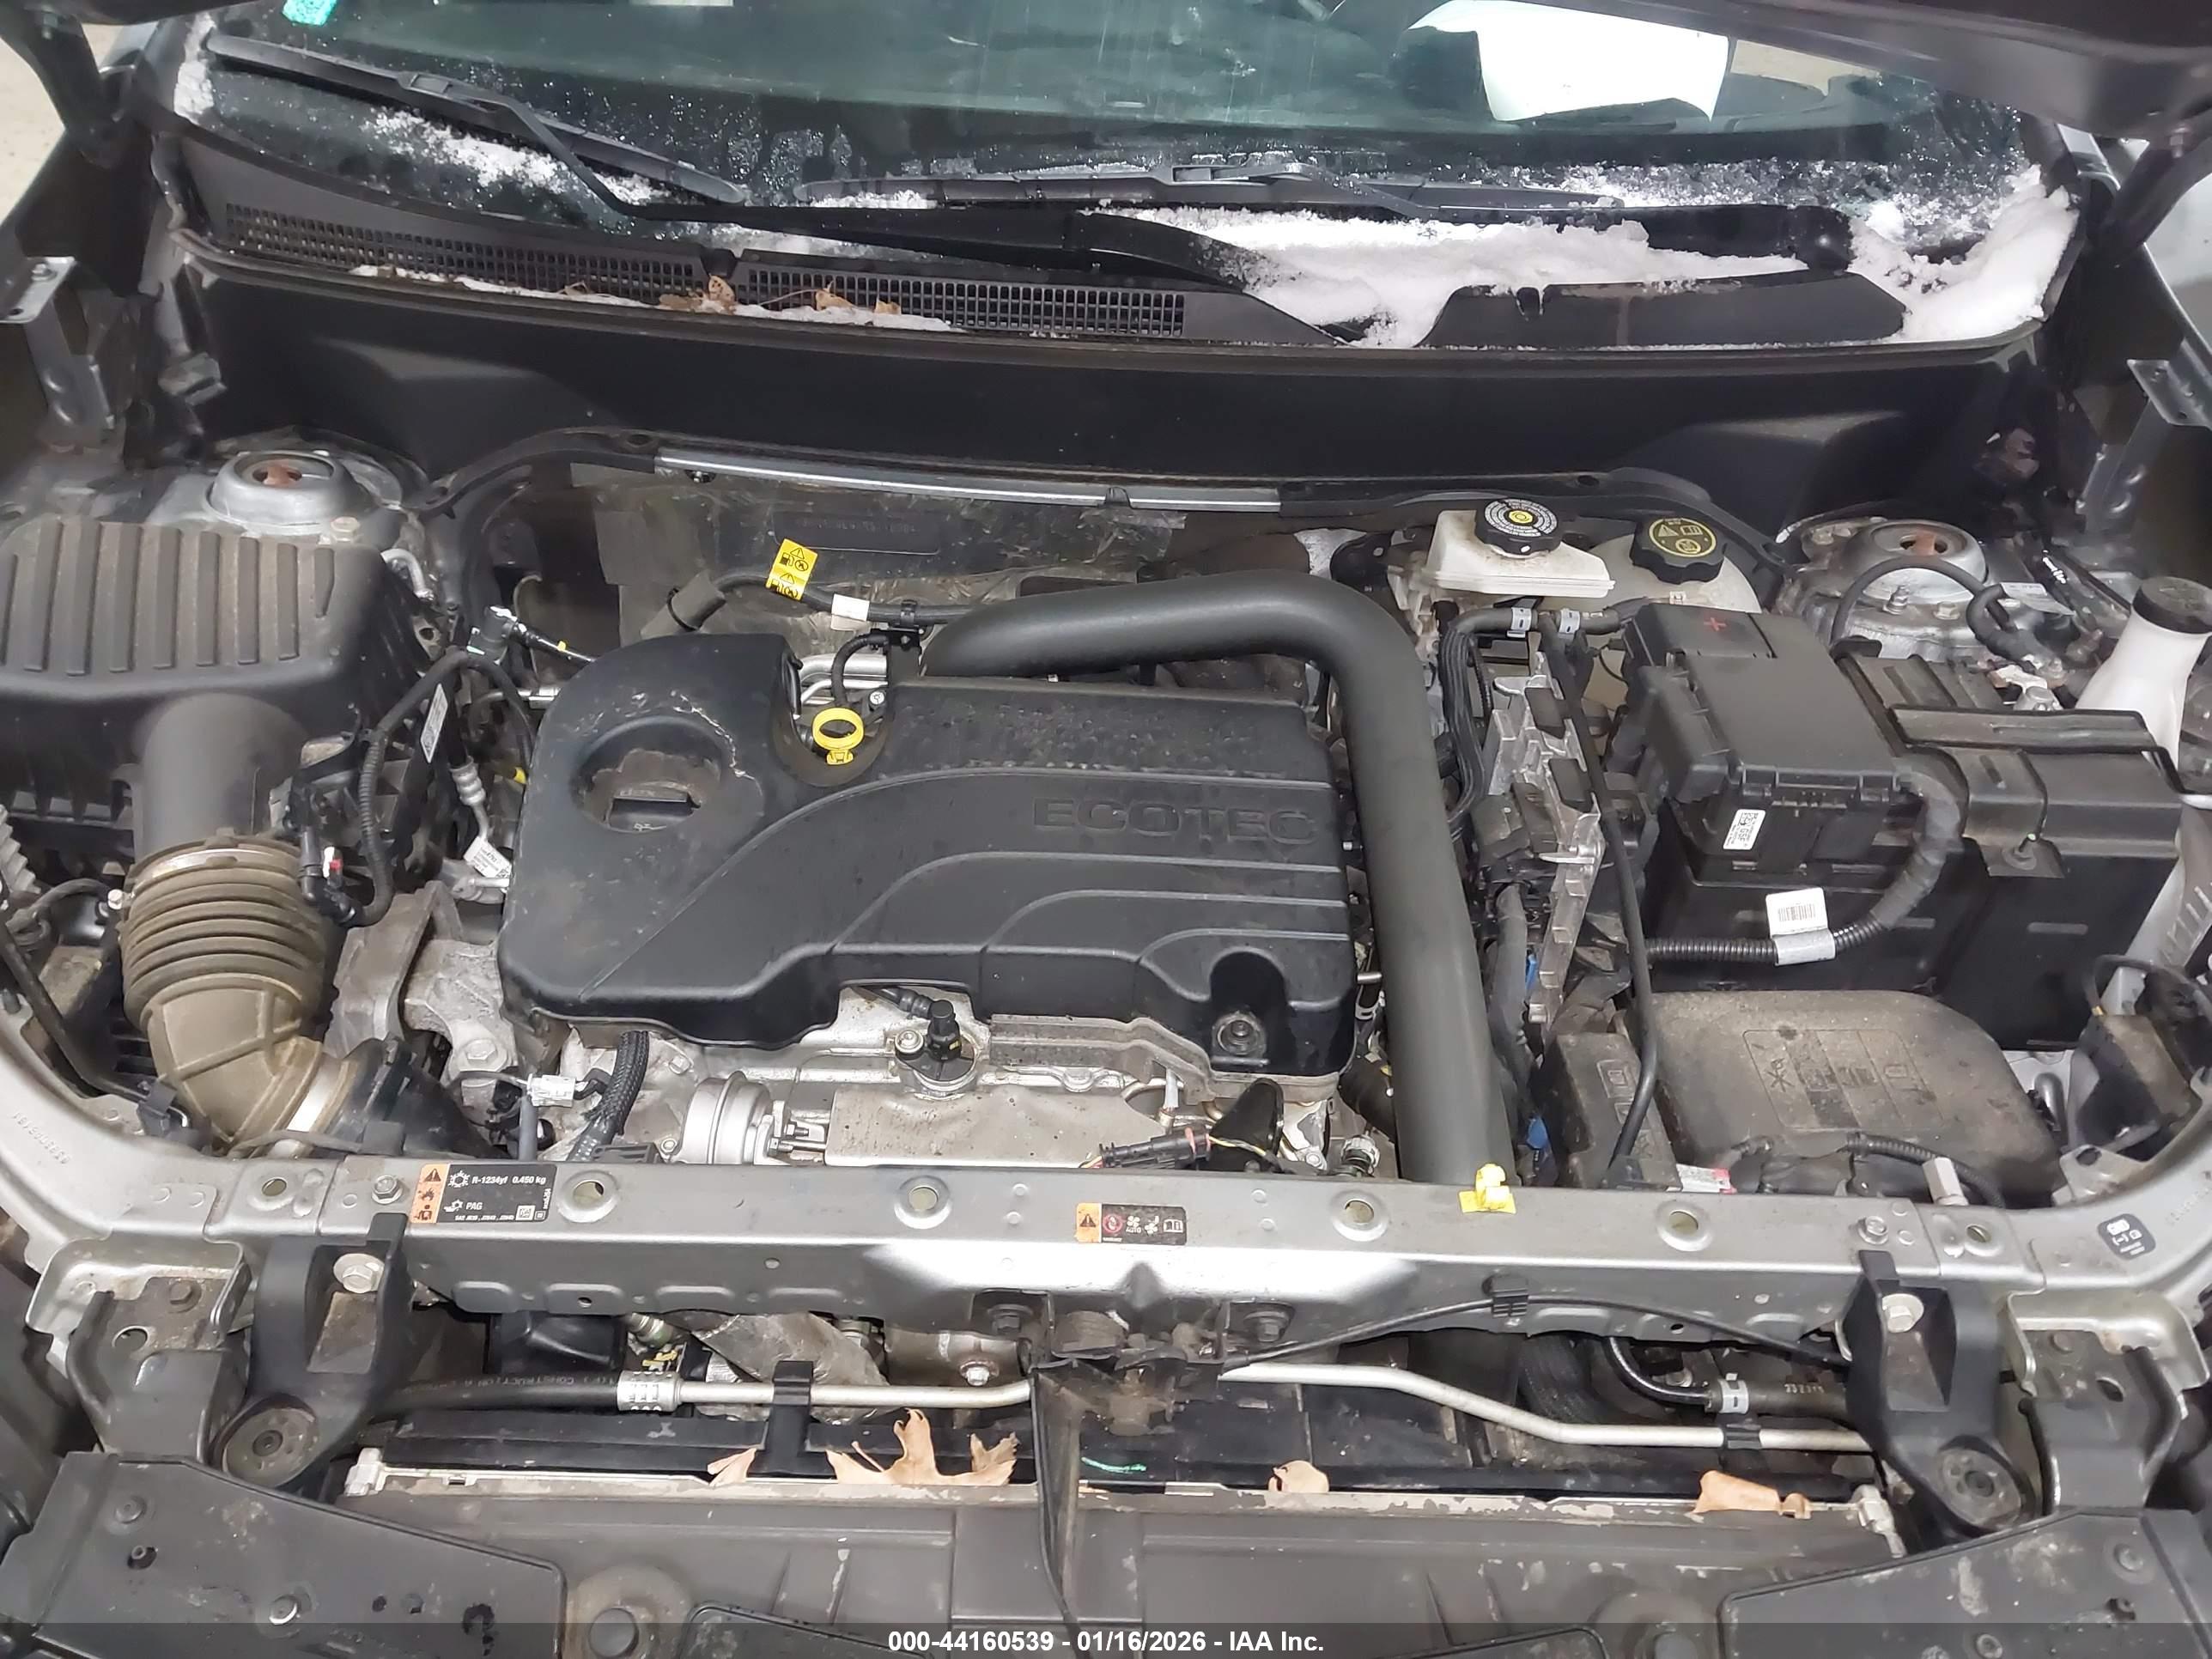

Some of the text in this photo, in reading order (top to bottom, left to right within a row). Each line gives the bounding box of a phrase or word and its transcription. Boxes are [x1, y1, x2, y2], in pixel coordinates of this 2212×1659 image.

[1033, 797, 1318, 845] ECOTEC
[471, 1176, 546, 1185] R-1234yf 0.450 kg
[465, 1201, 483, 1211] PAG
